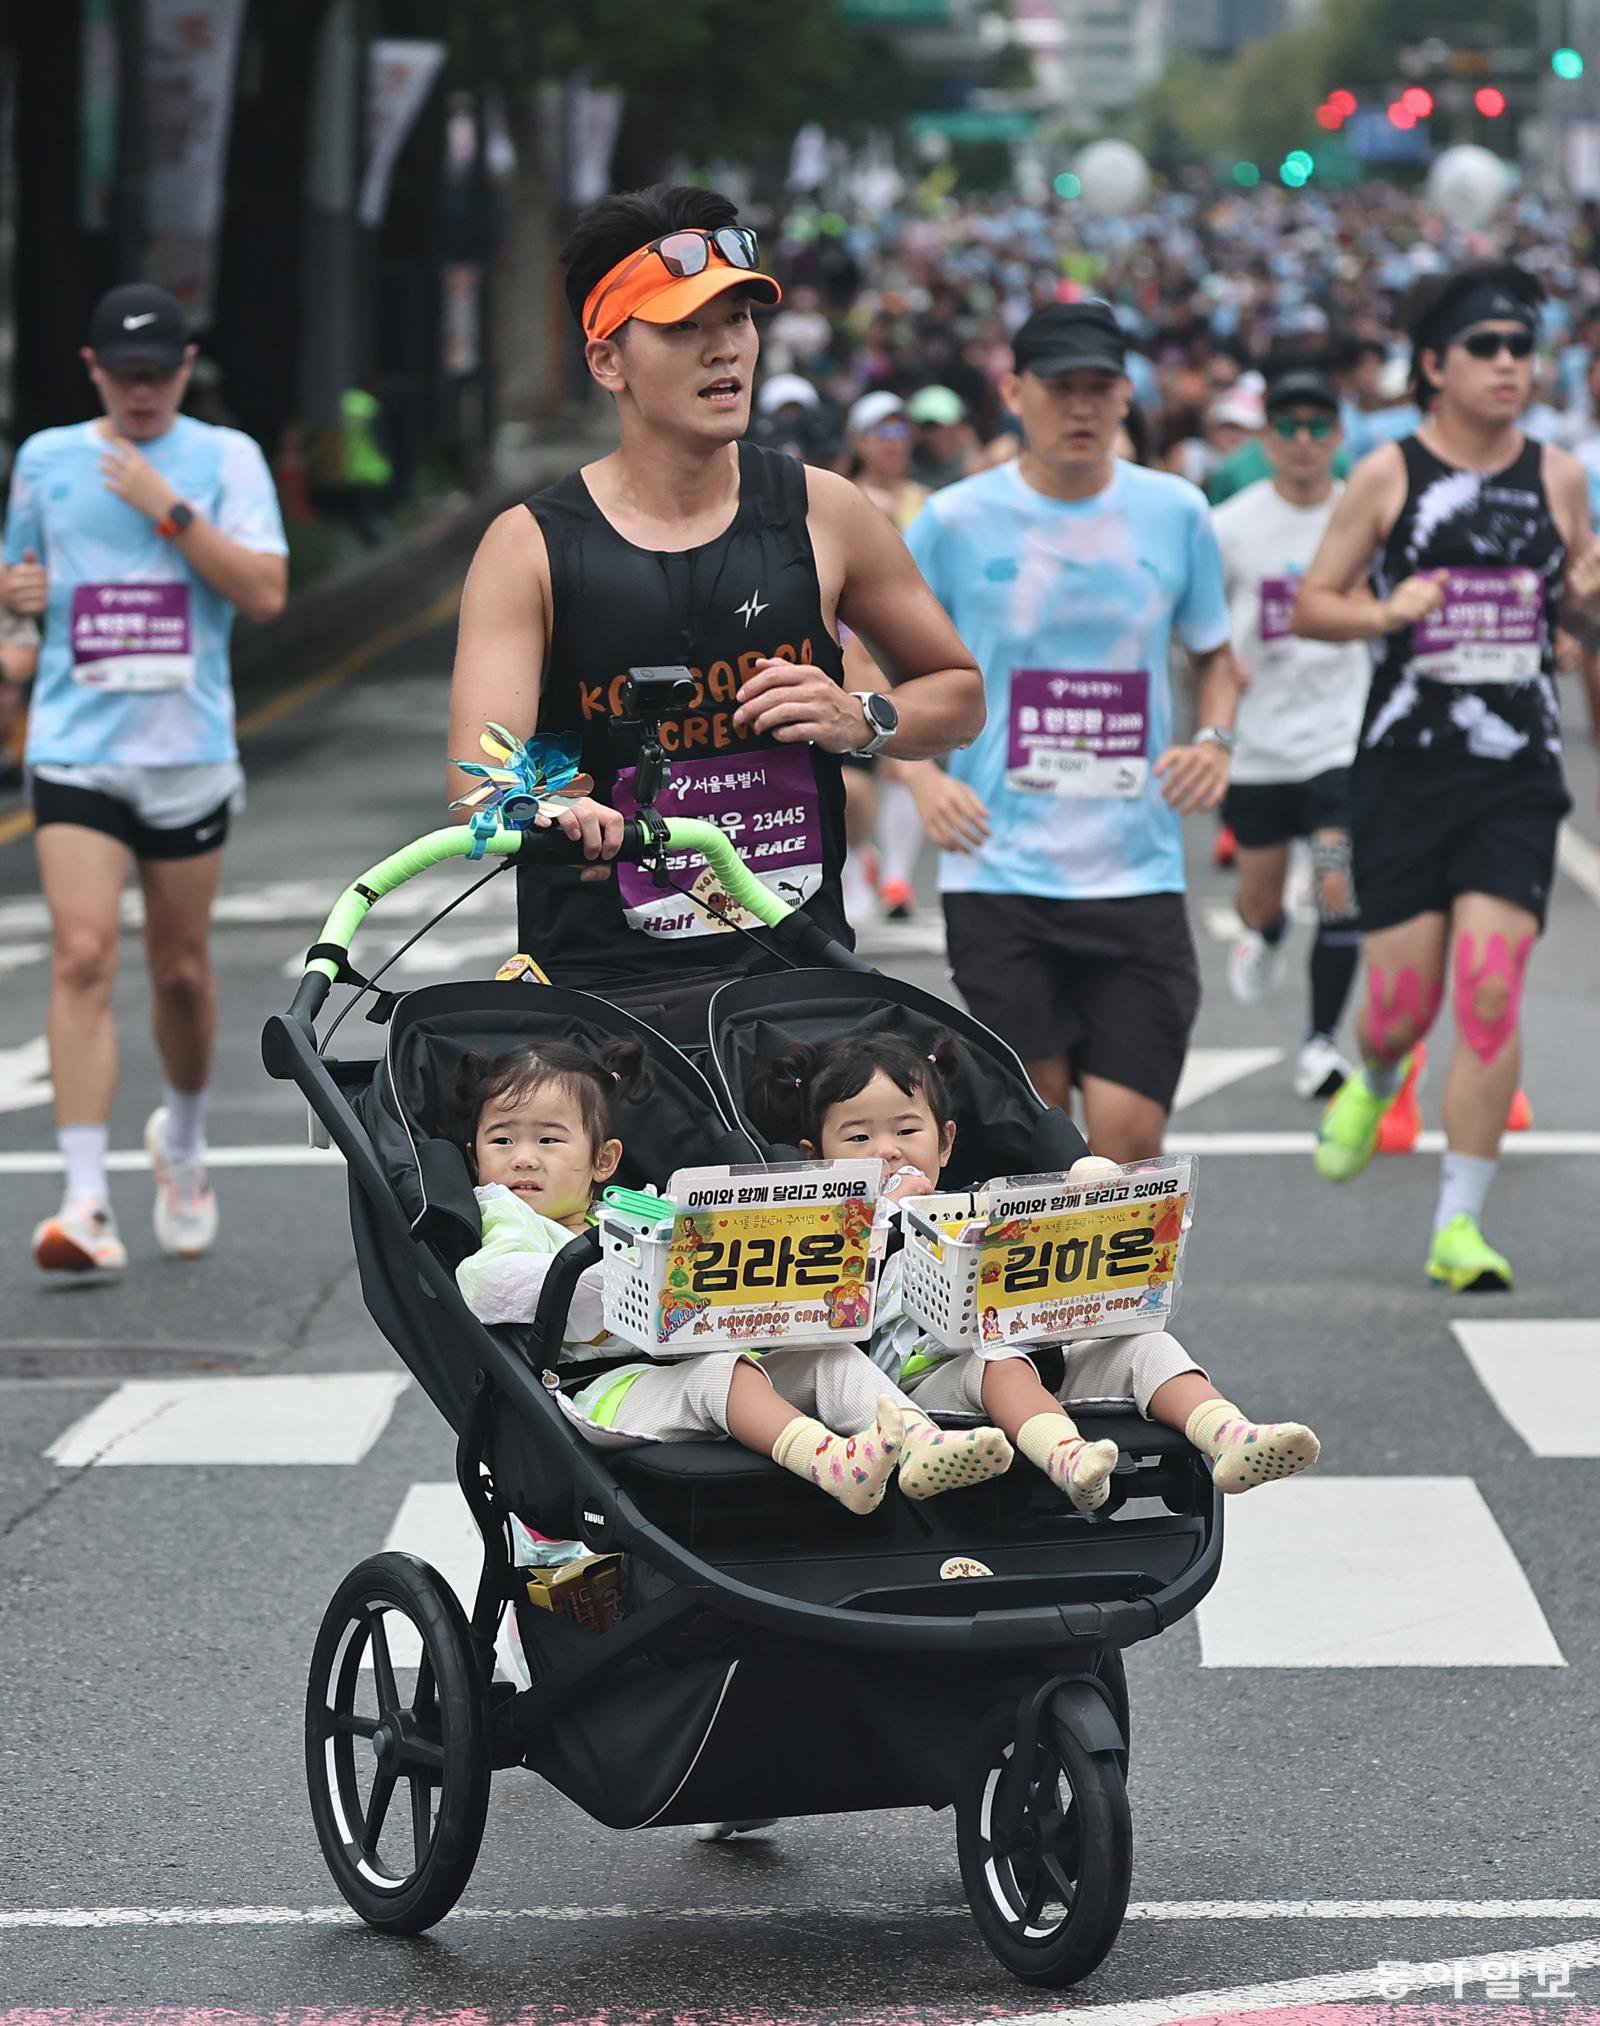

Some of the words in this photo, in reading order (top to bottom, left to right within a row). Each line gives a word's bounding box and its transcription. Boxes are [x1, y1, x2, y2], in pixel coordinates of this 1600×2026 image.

[694, 769, 767, 795] 서울특별시
[753, 806, 806, 832] 23445
[754, 836, 807, 858] RACE
[643, 912, 696, 932] Half
[689, 1190, 735, 1208] 아이와
[737, 1186, 768, 1203] 함께
[772, 1184, 818, 1201] 달리고
[822, 1181, 868, 1199] 있어요
[1000, 1198, 1047, 1218] 아이와
[1050, 1192, 1081, 1211] 함께
[1084, 1187, 1129, 1206] 달리고
[1132, 1179, 1179, 1200] 있어요
[786, 1214, 815, 1226] 주세요
[692, 1234, 845, 1293] 김라온
[1004, 1227, 1155, 1294] 김하온
[717, 1312, 790, 1330] KANGAROO
[794, 1308, 831, 1323] CREW
[1031, 1301, 1101, 1326] KANGAROO
[1105, 1295, 1144, 1311] CREW
[657, 1306, 696, 1343] Sparkle
[583, 1511, 605, 1526] THULE
